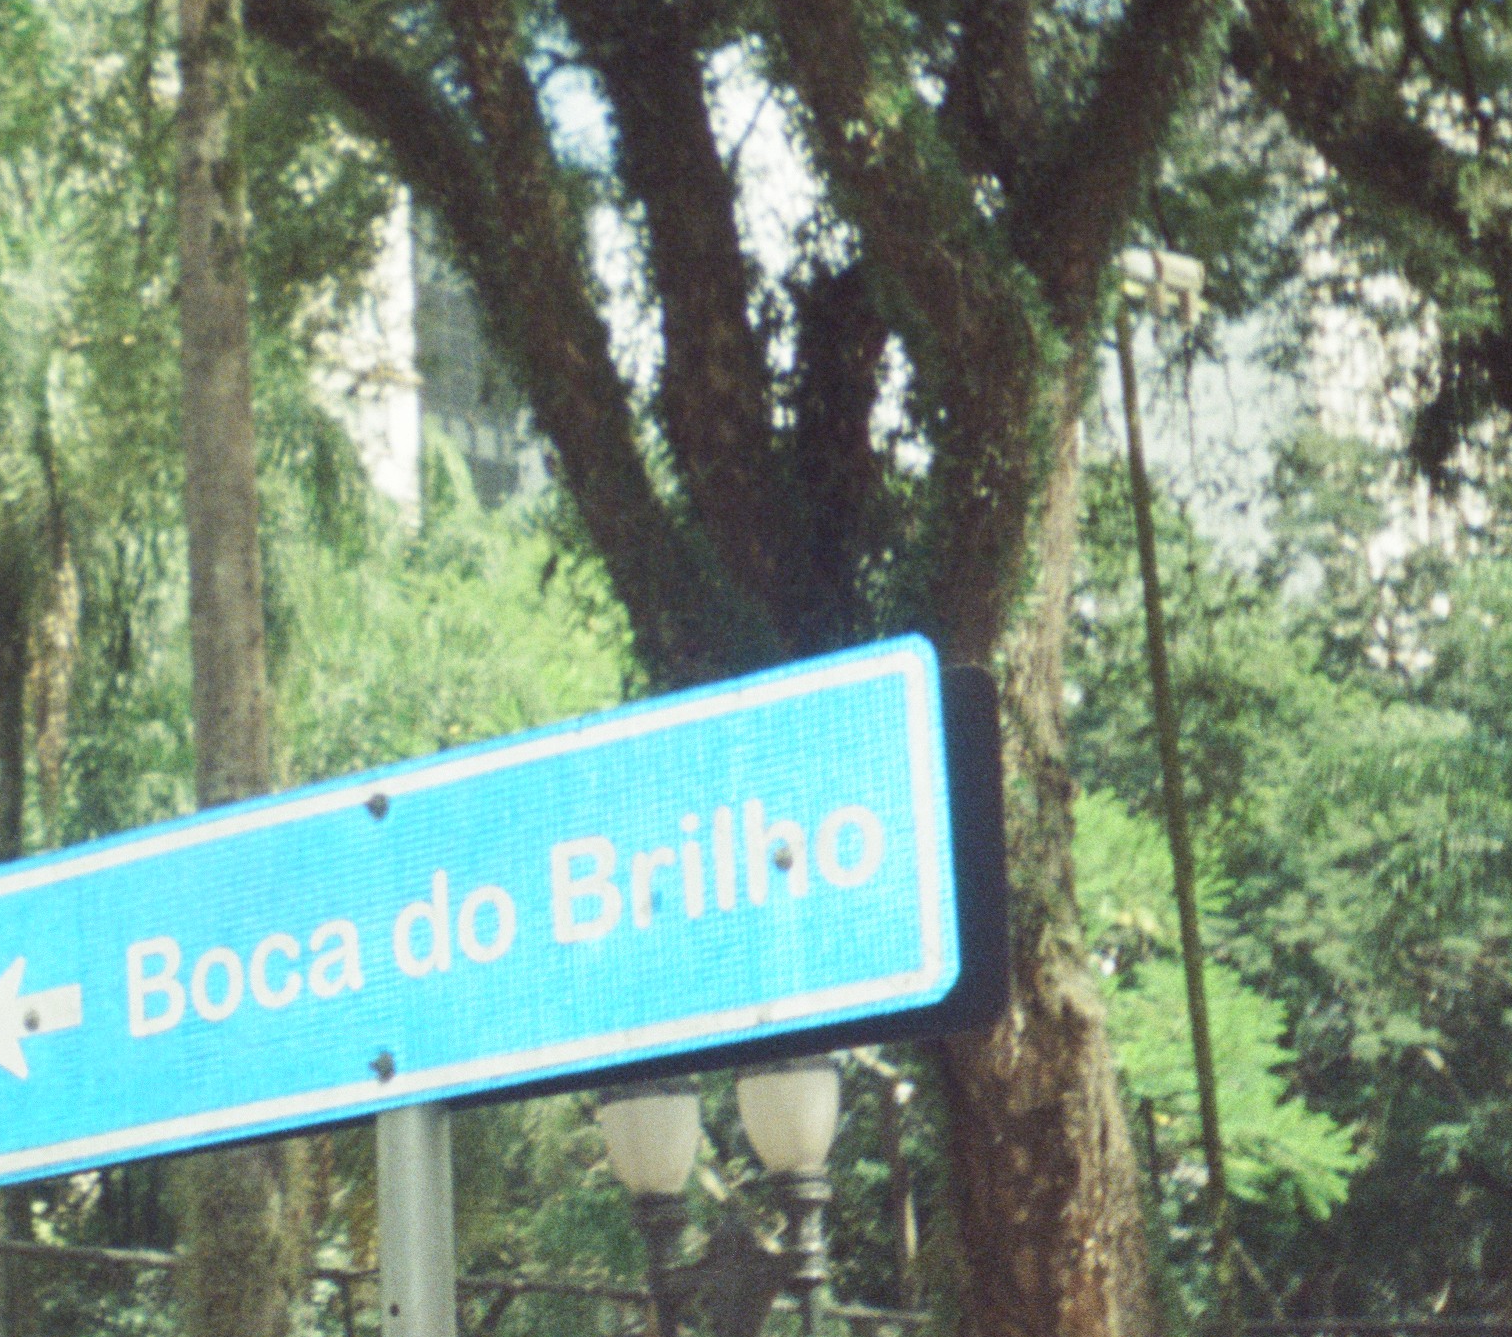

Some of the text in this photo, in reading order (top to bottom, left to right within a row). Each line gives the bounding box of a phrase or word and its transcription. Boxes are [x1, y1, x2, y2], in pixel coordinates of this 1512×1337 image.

[126, 798, 885, 1039] Boca do Brilho
